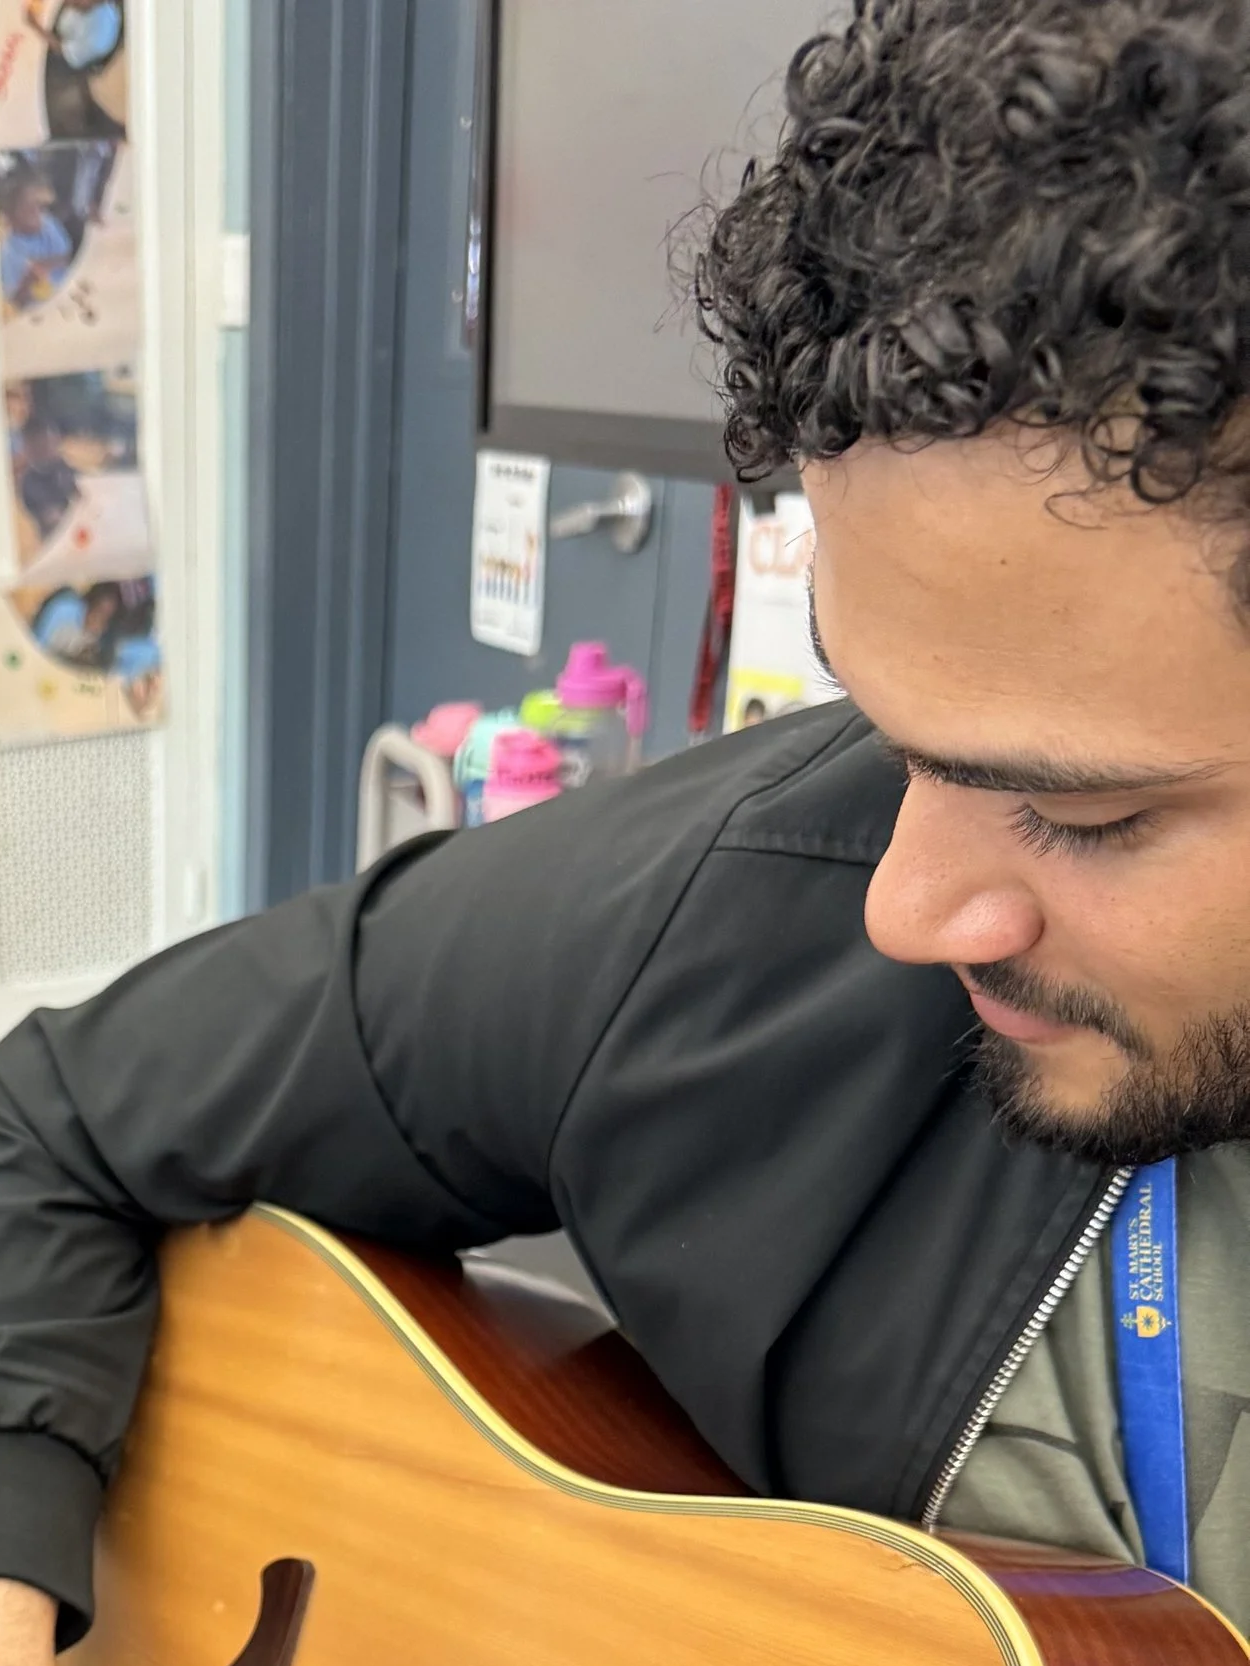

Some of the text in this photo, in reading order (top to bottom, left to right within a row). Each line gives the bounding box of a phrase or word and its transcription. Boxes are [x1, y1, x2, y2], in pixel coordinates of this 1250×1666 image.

[1128, 1217, 1139, 1273] MARY'S
[1138, 1183, 1152, 1301] CATHEDRAL
[1151, 1243, 1163, 1301] SCHOOL
